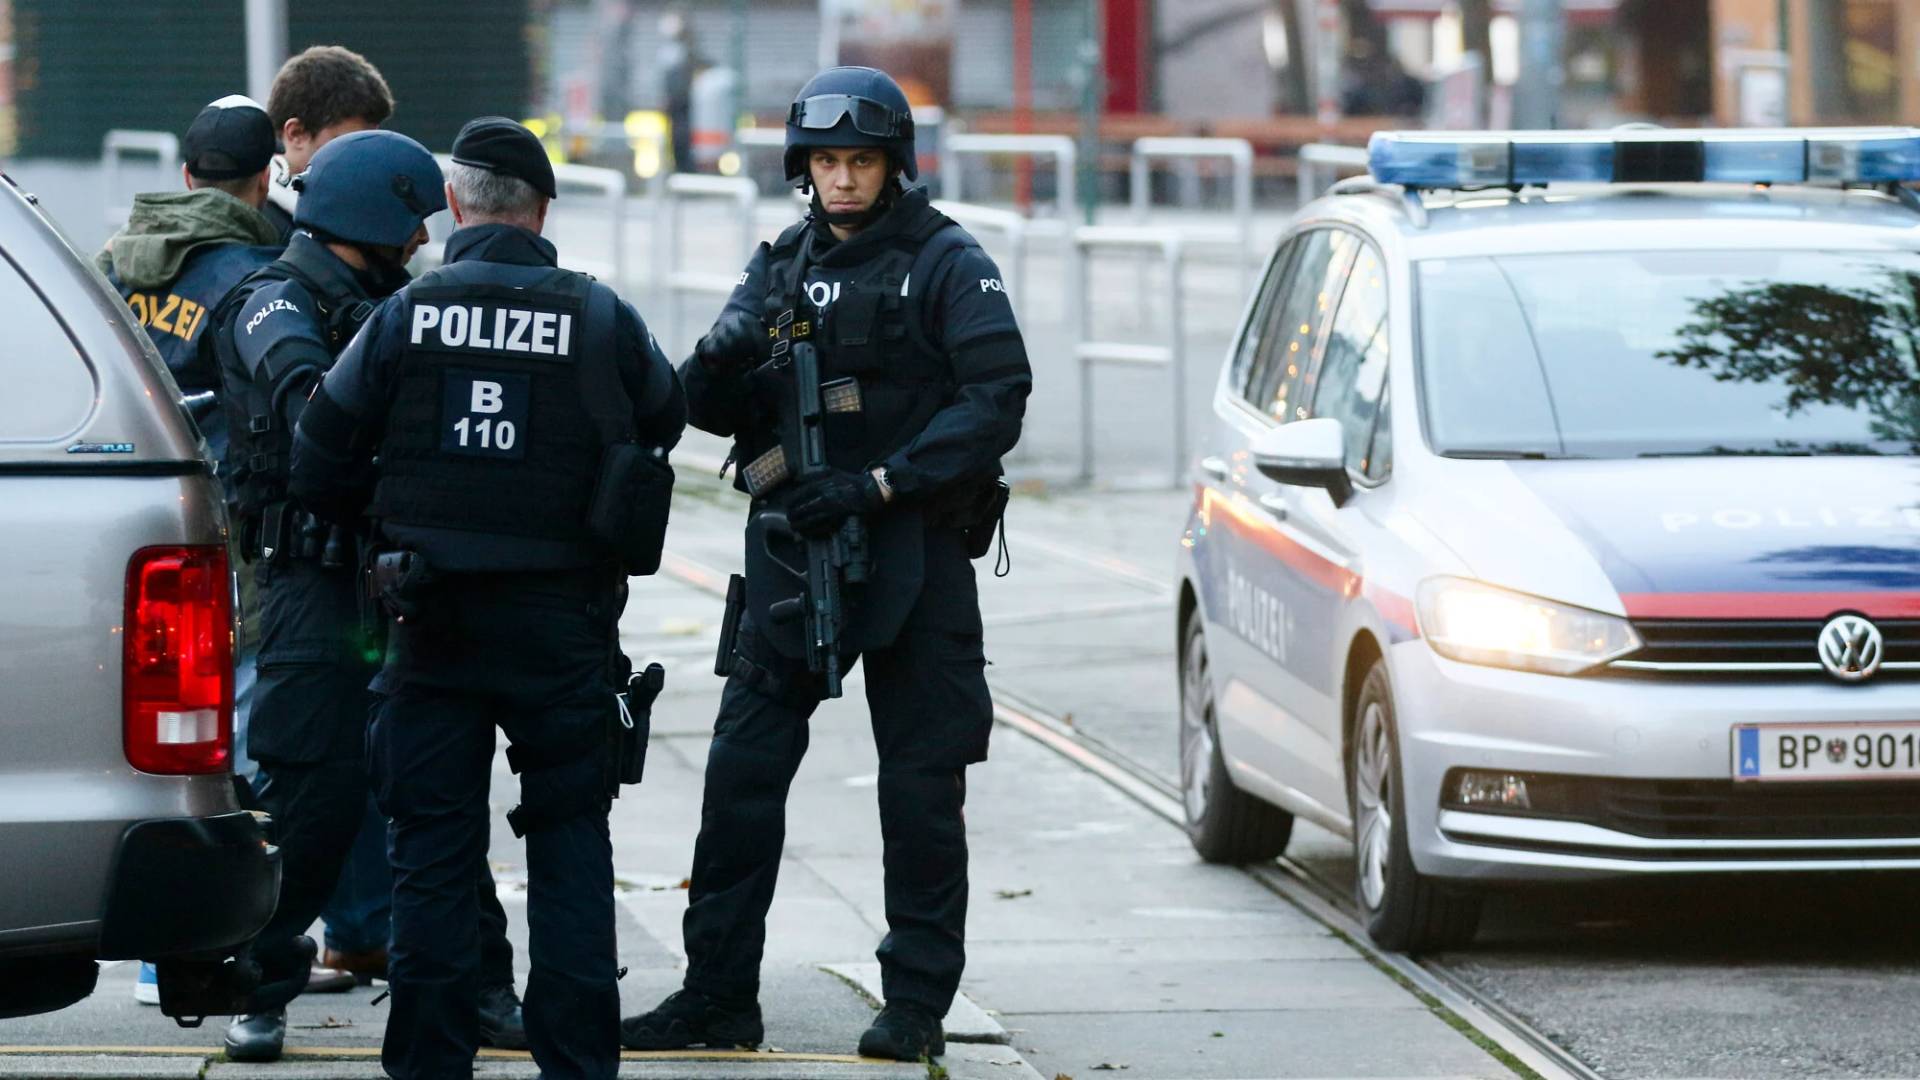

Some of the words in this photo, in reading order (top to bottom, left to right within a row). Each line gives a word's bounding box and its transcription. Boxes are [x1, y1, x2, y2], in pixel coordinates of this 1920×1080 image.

[411, 304, 572, 356] POLIZEI
[470, 380, 503, 414] B
[454, 417, 516, 450] 110
[1779, 734, 1822, 769] BP
[1854, 732, 1920, 768] 901
